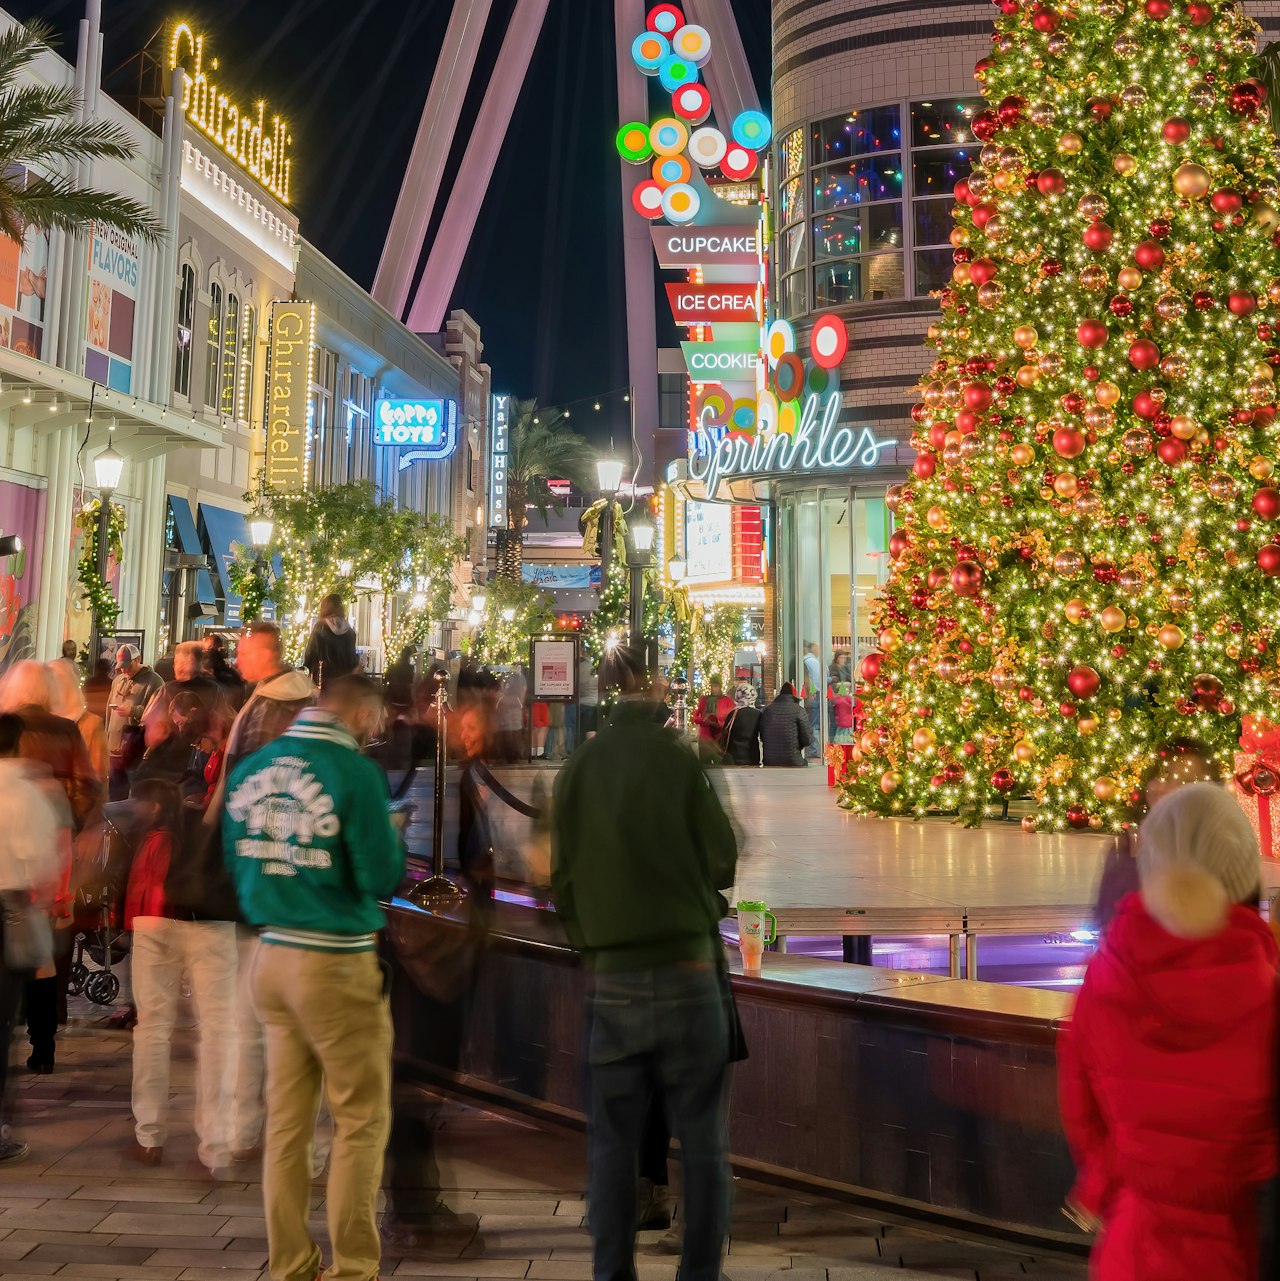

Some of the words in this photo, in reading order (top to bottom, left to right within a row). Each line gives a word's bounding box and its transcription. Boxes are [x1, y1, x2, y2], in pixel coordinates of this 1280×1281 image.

[170, 22, 292, 204] Ghirardelli
[93, 239, 138, 288] FLAVORS
[110, 231, 138, 259] ORIGINAL
[677, 295, 705, 310] ICE
[708, 295, 756, 310] CREA
[691, 353, 758, 369] COOKIE
[269, 311, 305, 486] Ghirardelli
[495, 395, 510, 452] Yard
[381, 425, 434, 443] TOYS
[689, 391, 899, 500] Sprinkles
[494, 455, 507, 524] House
